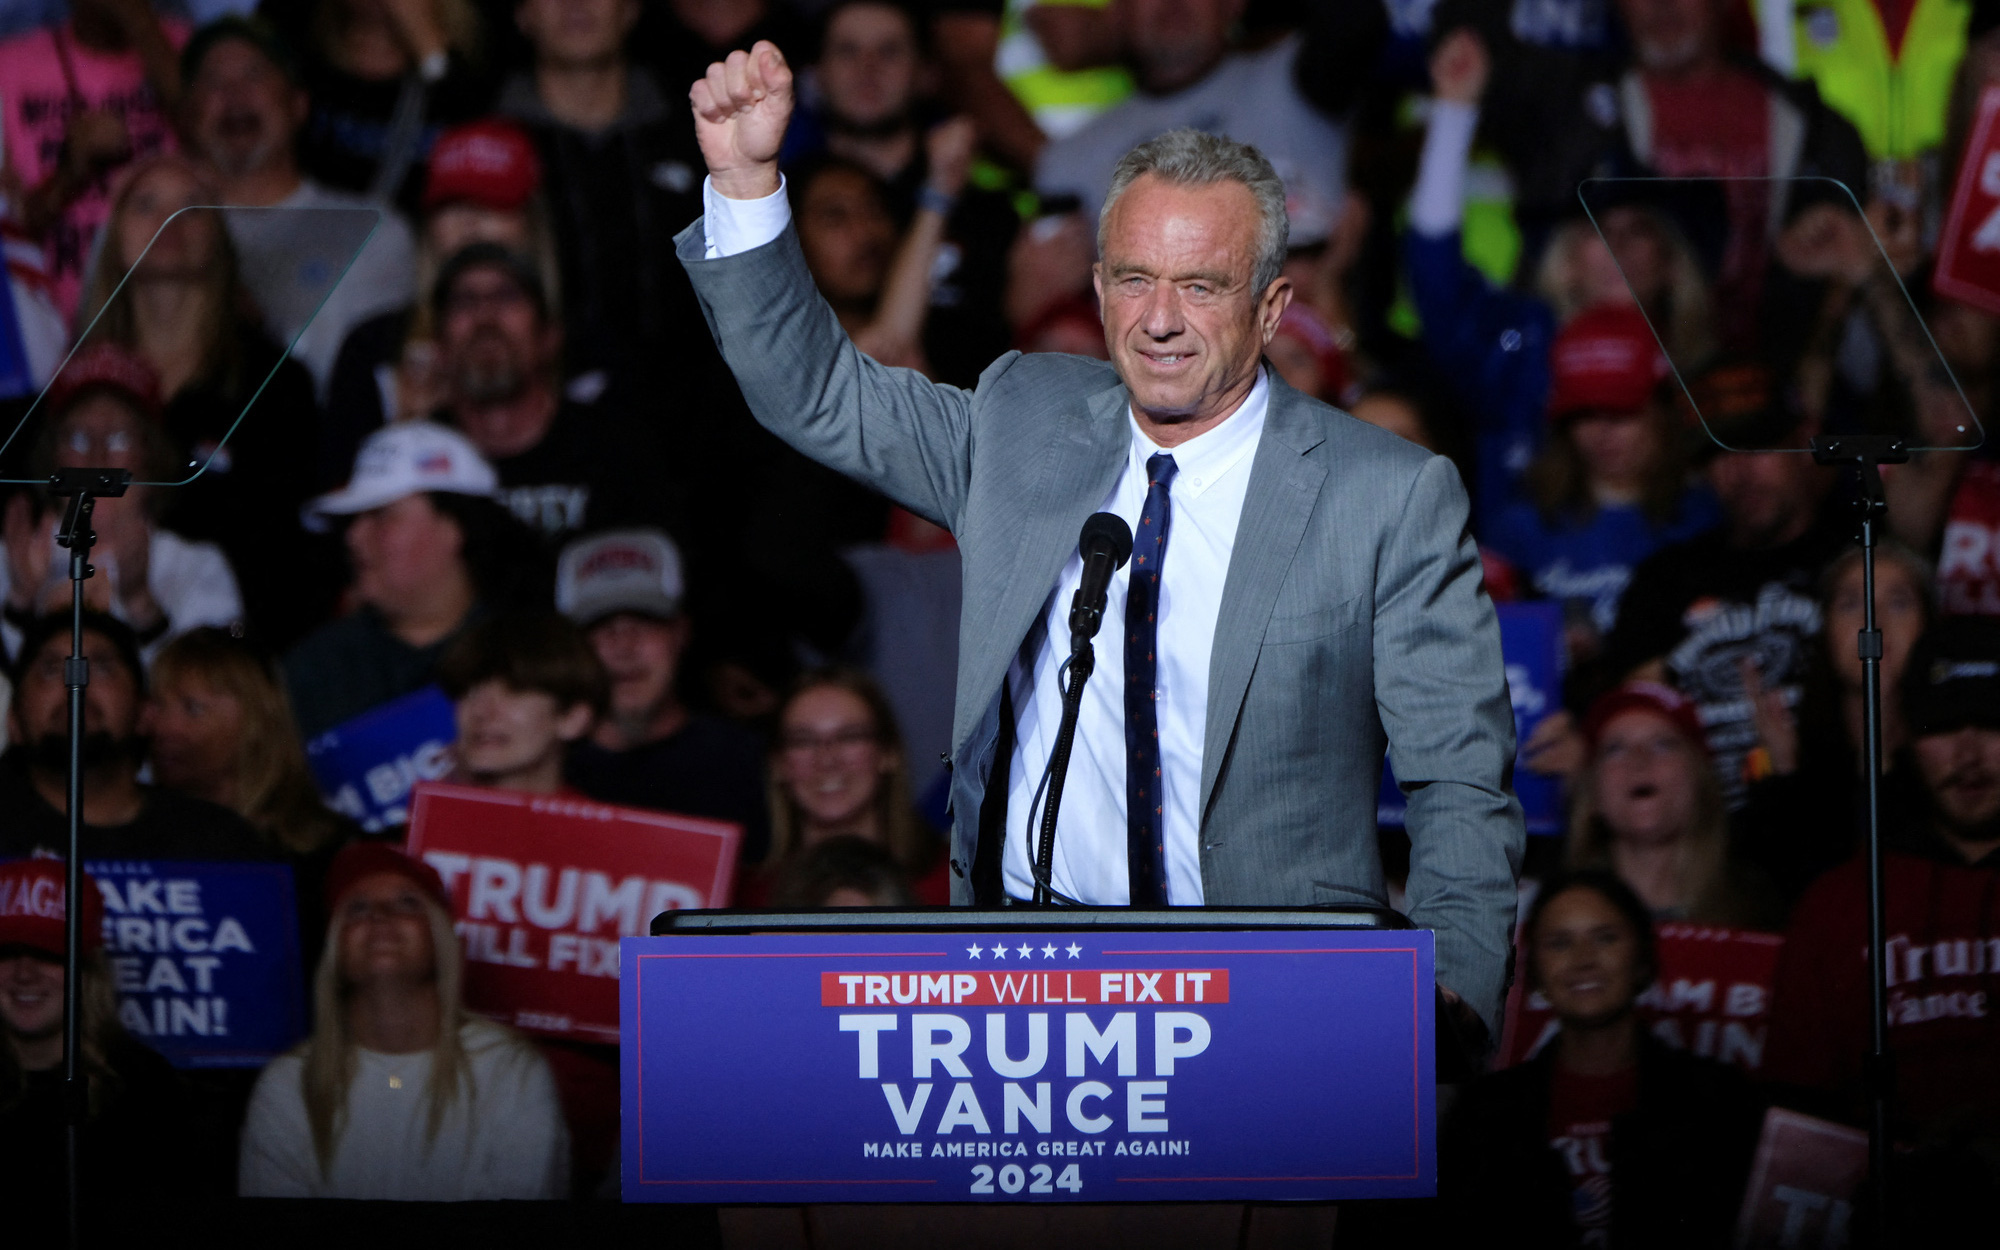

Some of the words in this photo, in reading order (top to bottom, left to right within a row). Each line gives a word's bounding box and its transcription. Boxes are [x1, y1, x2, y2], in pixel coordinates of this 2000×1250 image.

[95, 878, 204, 915] AKE
[102, 916, 256, 953] RICA
[112, 955, 222, 993] EAT
[838, 974, 978, 1004] TRUMP
[988, 973, 1087, 1003] WILL
[1100, 972, 1163, 1002] FIX
[1175, 972, 1212, 1002] IT
[118, 997, 229, 1037] AIN!
[838, 1011, 1212, 1079] TRUMP
[881, 1080, 1169, 1135] VANCE
[863, 1142, 923, 1158] MAKE
[930, 1141, 1028, 1157] AMERICA
[1036, 1141, 1106, 1157] GREAT
[1114, 1140, 1190, 1156] AGAIN!
[970, 1163, 1083, 1194] 2024
